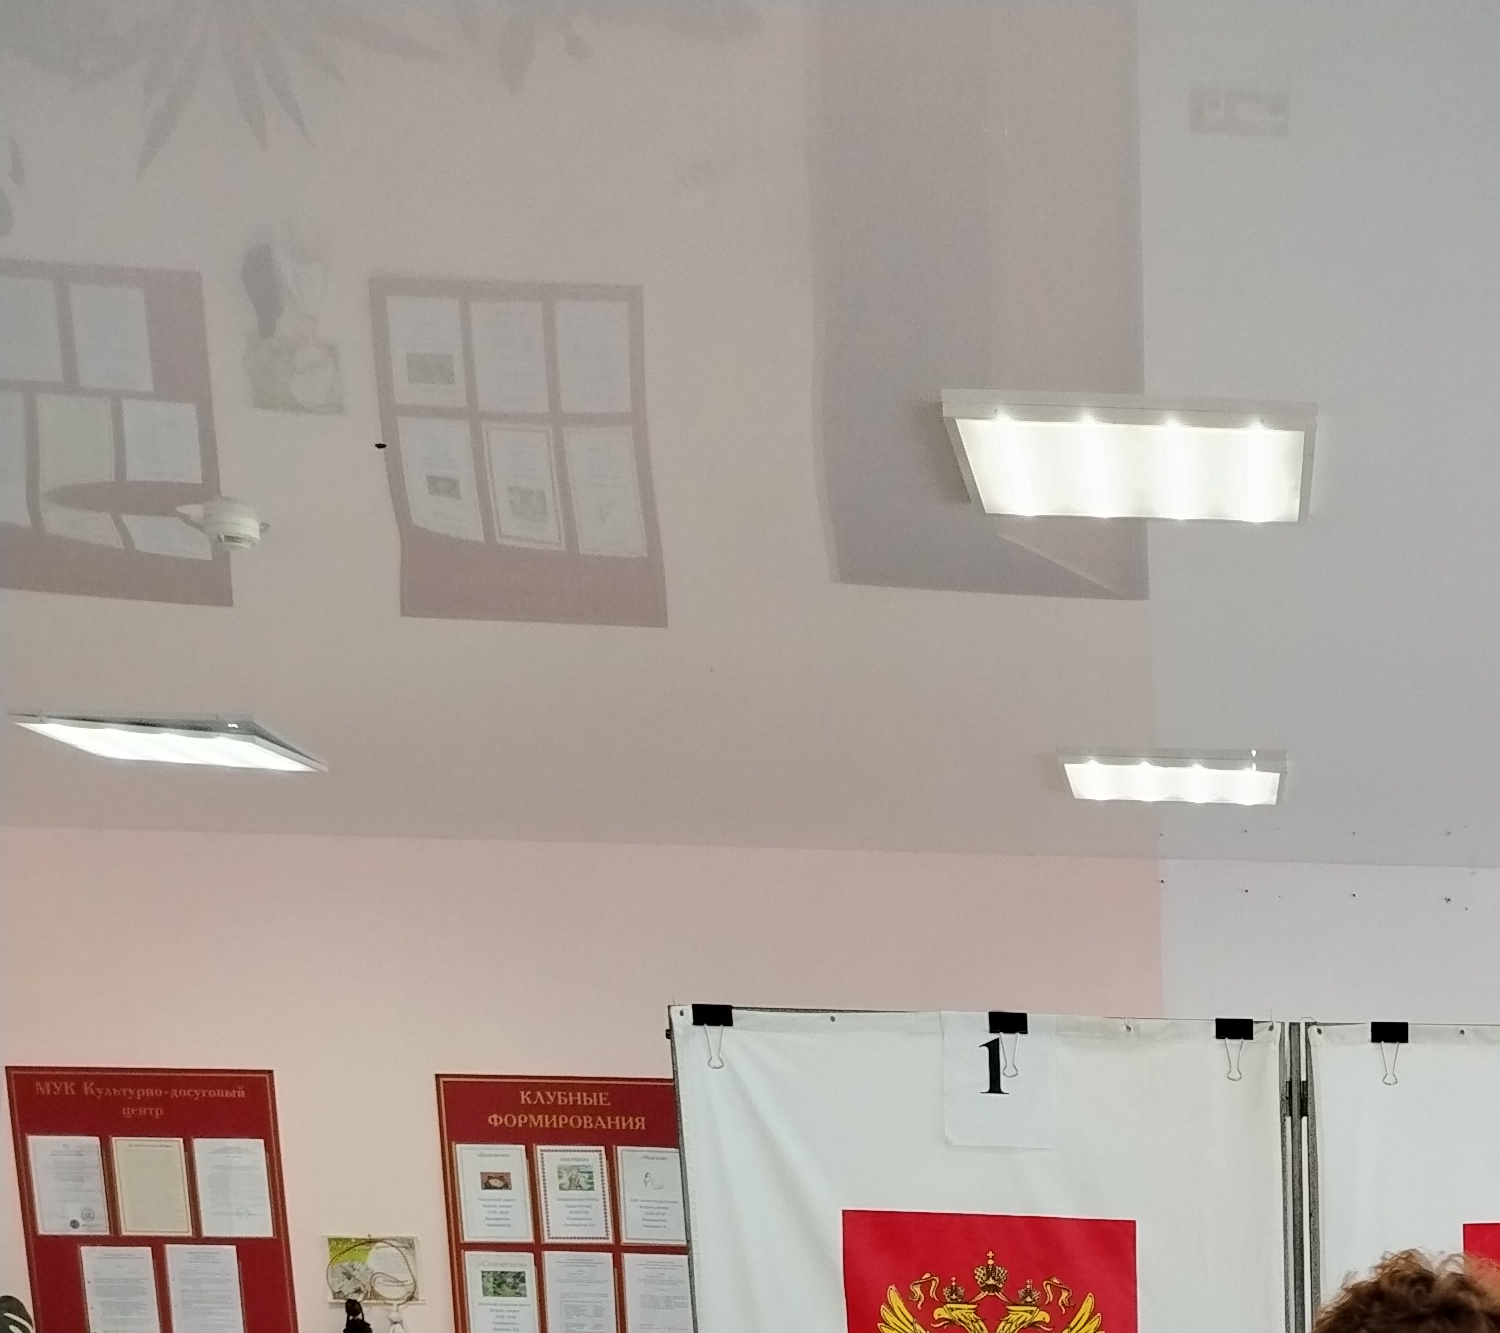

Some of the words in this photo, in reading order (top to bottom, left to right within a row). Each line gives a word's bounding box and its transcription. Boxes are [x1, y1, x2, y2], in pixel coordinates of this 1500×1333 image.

[978, 1037, 1010, 1095] 1
[35, 1081, 76, 1096] МУК
[83, 1081, 246, 1100] Культурно-досуговый
[520, 1090, 611, 1107] КЛУБНЫЕ
[121, 1106, 165, 1119] центр
[487, 1113, 647, 1131] ФОРМИРОВАНИЯ
